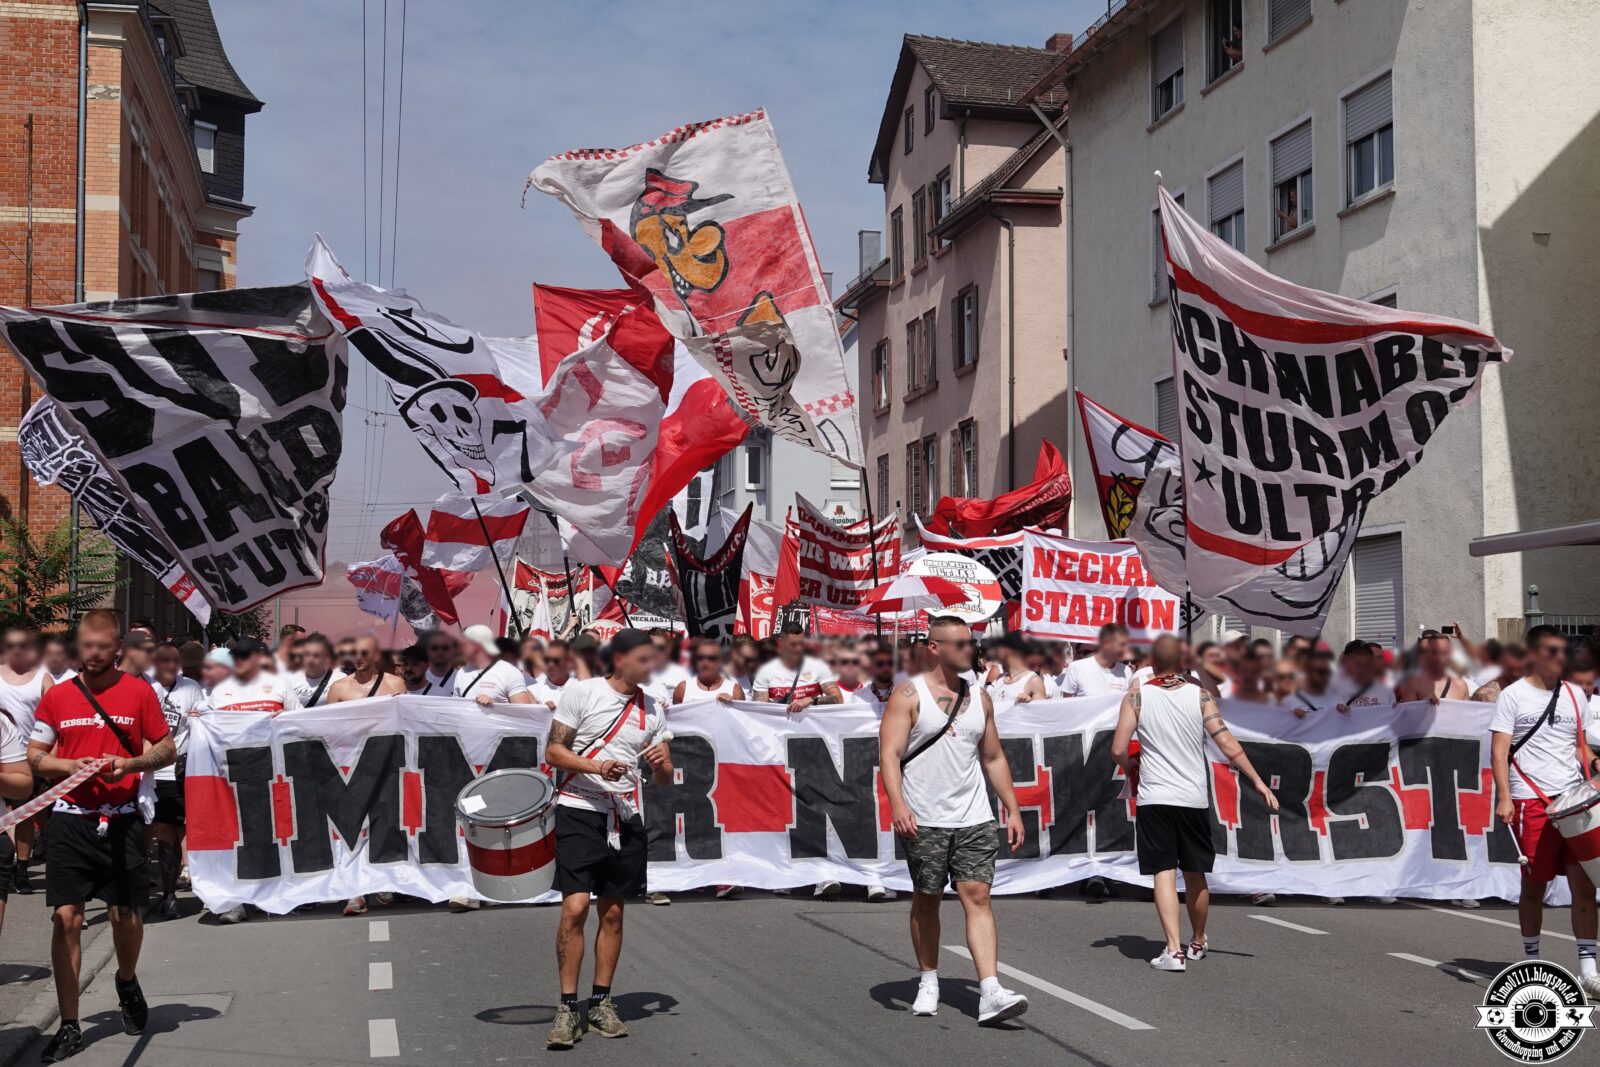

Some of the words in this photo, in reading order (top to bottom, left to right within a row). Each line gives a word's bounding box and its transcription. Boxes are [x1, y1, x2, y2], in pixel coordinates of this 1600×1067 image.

[1183, 369, 1400, 480] STURM
[800, 540, 824, 564] DIE
[929, 567, 976, 579] ULTRAS
[1031, 546, 1159, 588] NECKA
[800, 576, 822, 599] ER
[827, 584, 867, 606] ULT
[1024, 588, 1176, 630] STADION
[225, 731, 724, 882] IMMR
[783, 728, 1522, 867] NKRST
